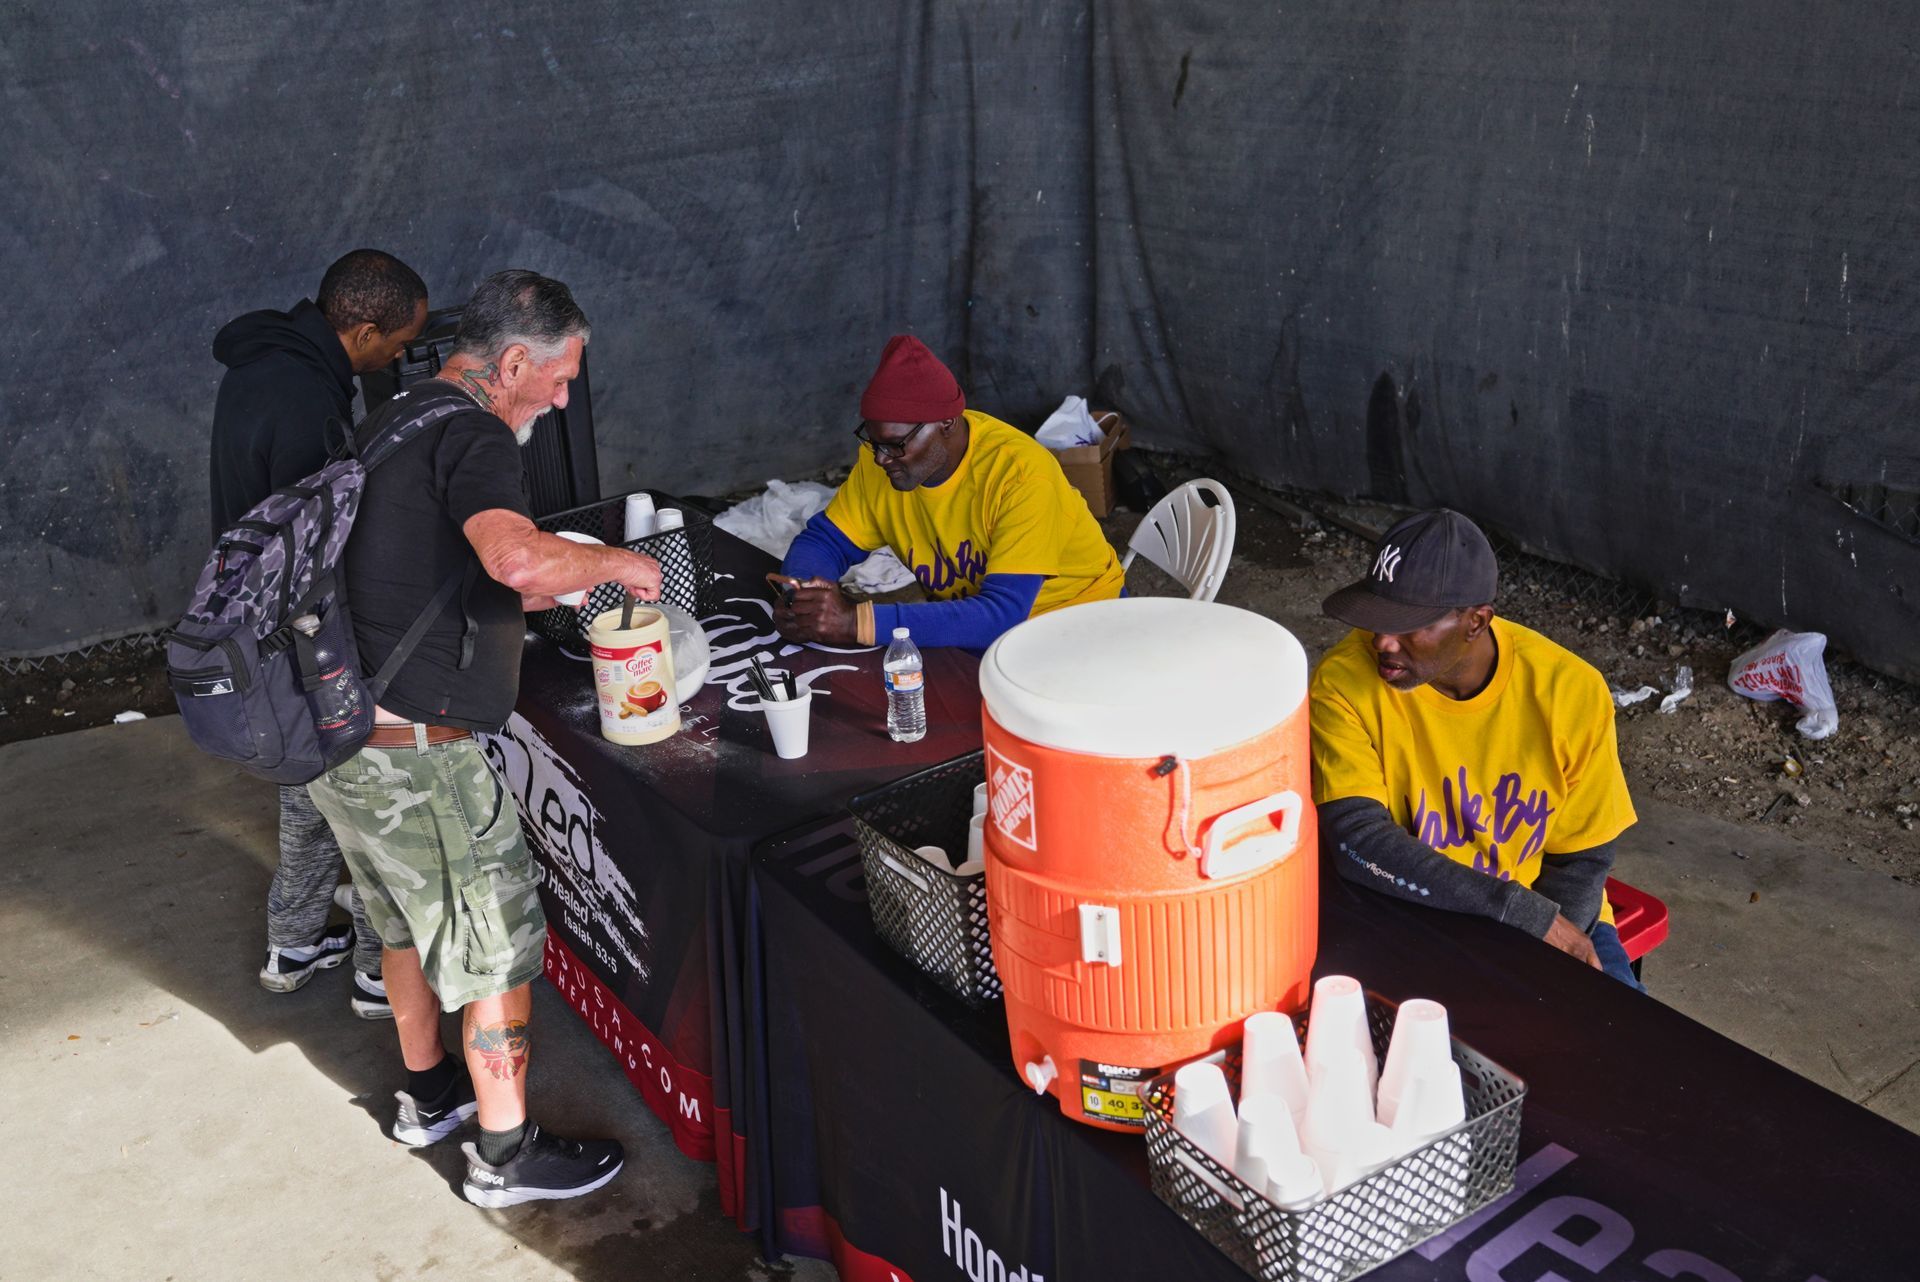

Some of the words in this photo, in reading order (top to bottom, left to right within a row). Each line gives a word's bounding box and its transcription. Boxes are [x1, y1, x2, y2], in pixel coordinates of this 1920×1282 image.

[626, 657, 653, 673] Coffee
[992, 769, 1031, 827] HOME
[1003, 797, 1031, 834] DEPOT
[1492, 772, 1555, 866] By
[564, 909, 593, 949] Isaiah
[595, 941, 618, 974] 53:5
[1097, 1063, 1141, 1077] IGLOO
[1089, 1095, 1099, 1107] 10
[1108, 1099, 1125, 1109] 40
[472, 1167, 505, 1187] HOKA
